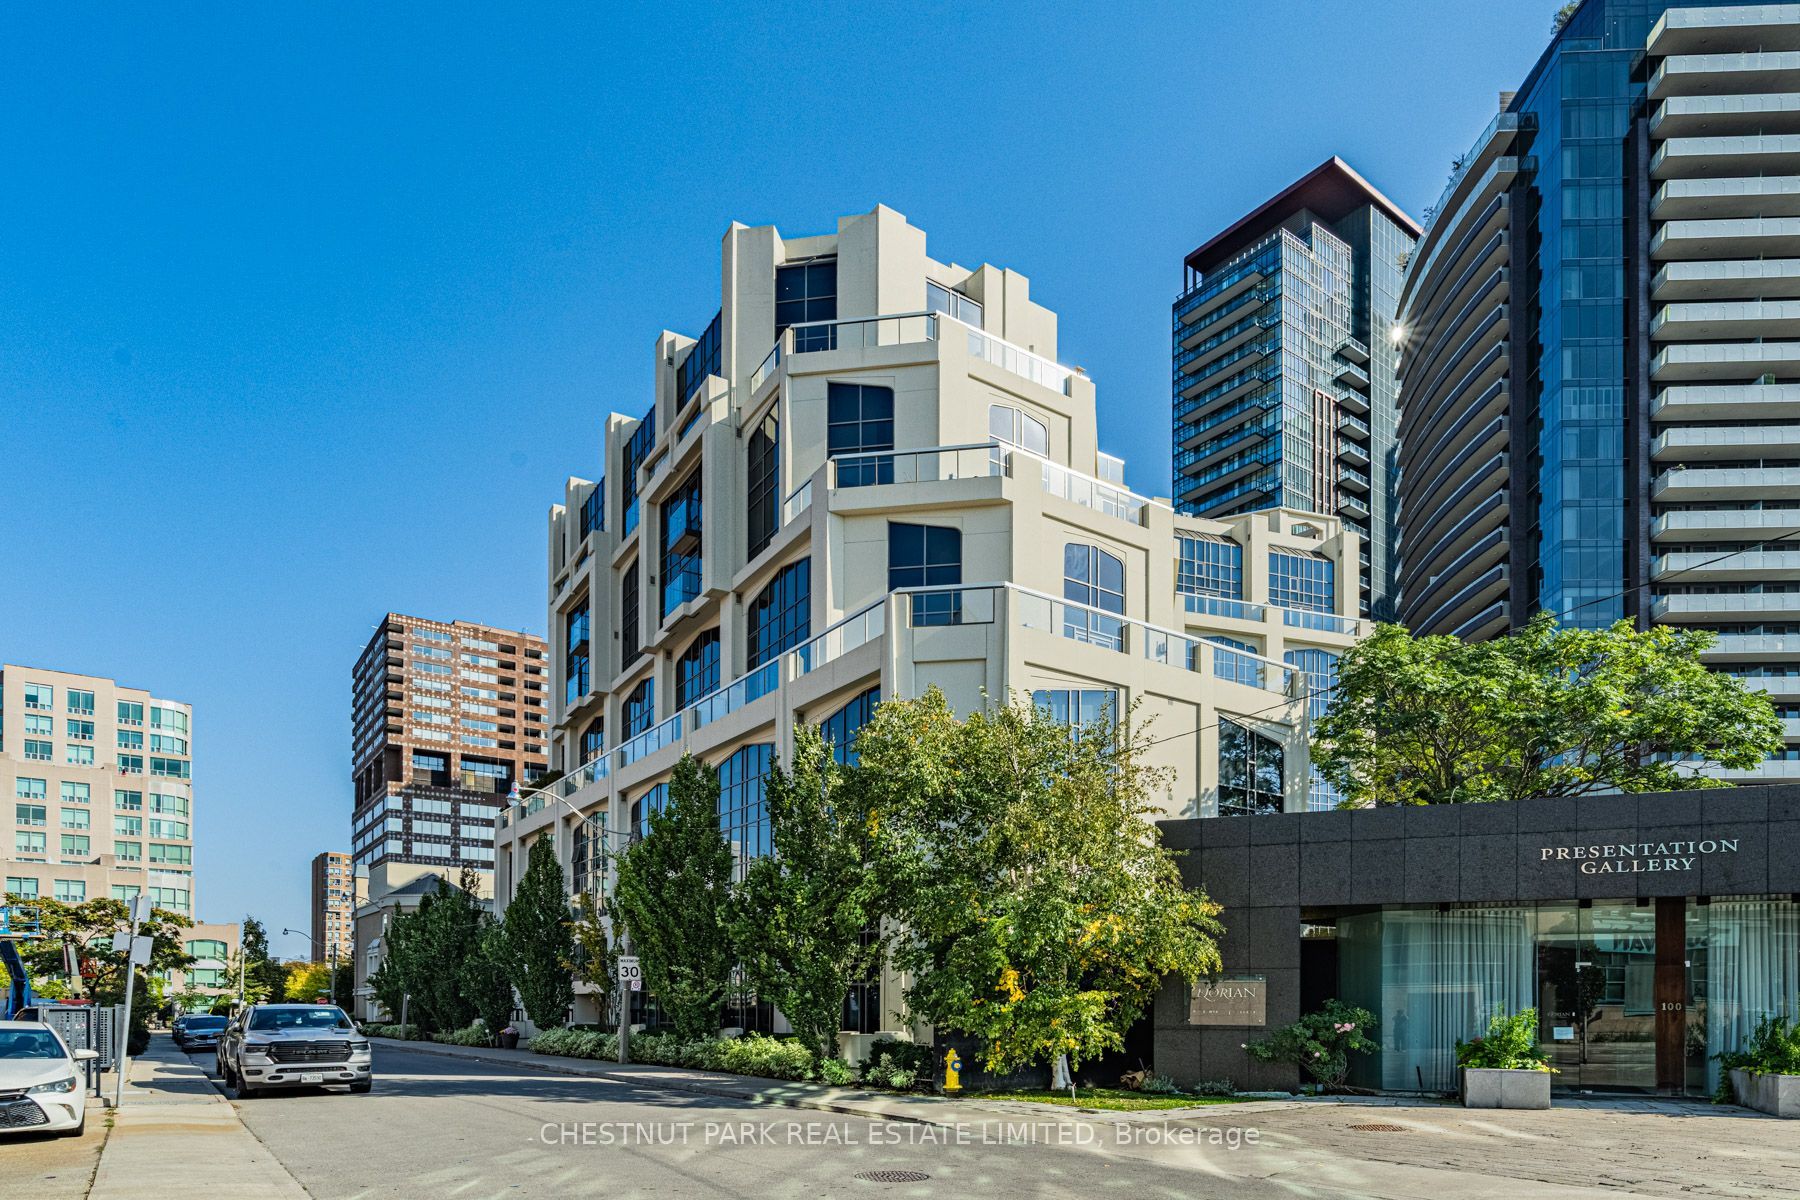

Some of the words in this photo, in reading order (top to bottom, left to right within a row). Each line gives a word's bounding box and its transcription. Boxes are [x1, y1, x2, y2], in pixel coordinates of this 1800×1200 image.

[1540, 839, 1740, 861] PRESENTATION
[1580, 857, 1697, 875] GALLERY
[621, 966, 639, 978] 30
[1661, 1002, 1682, 1011] 100
